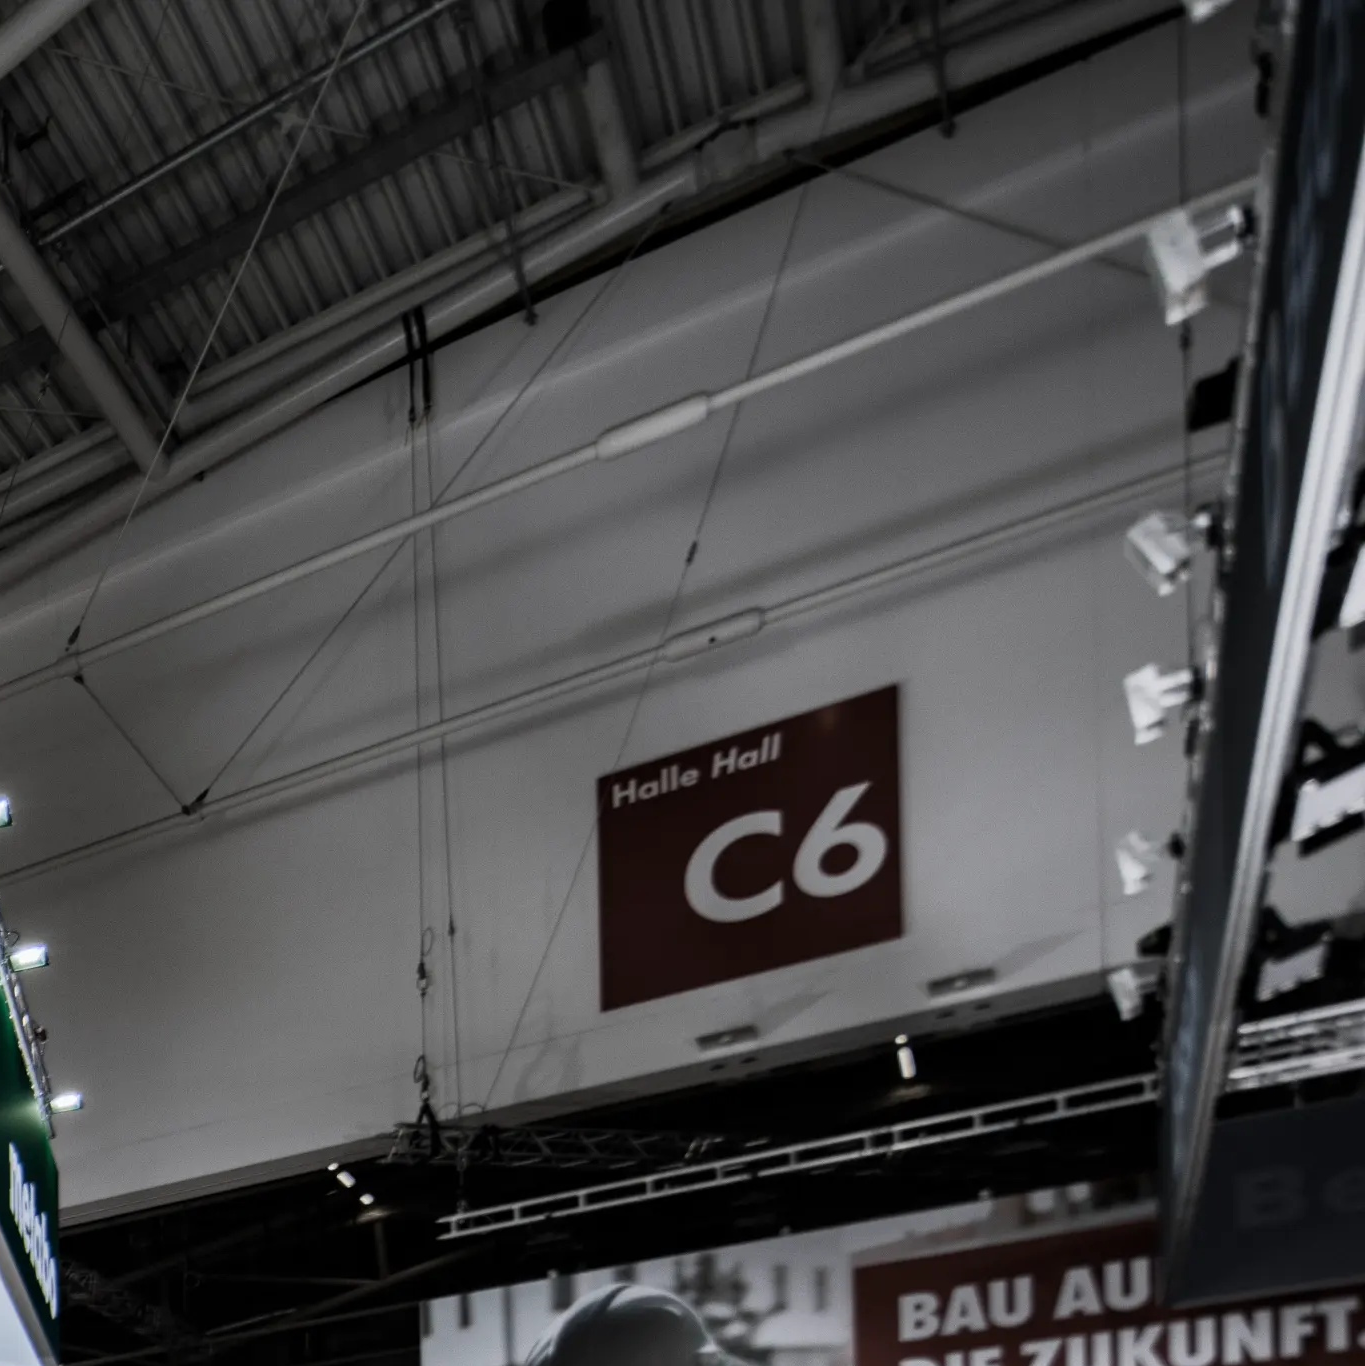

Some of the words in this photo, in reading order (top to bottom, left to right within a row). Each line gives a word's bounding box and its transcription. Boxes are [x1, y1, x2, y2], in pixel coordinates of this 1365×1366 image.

[612, 764, 699, 808] Halle
[711, 732, 781, 778] Hall
[684, 781, 887, 923] C6
[898, 1275, 1033, 1342] BAU
[1053, 1256, 1153, 1320] AU
